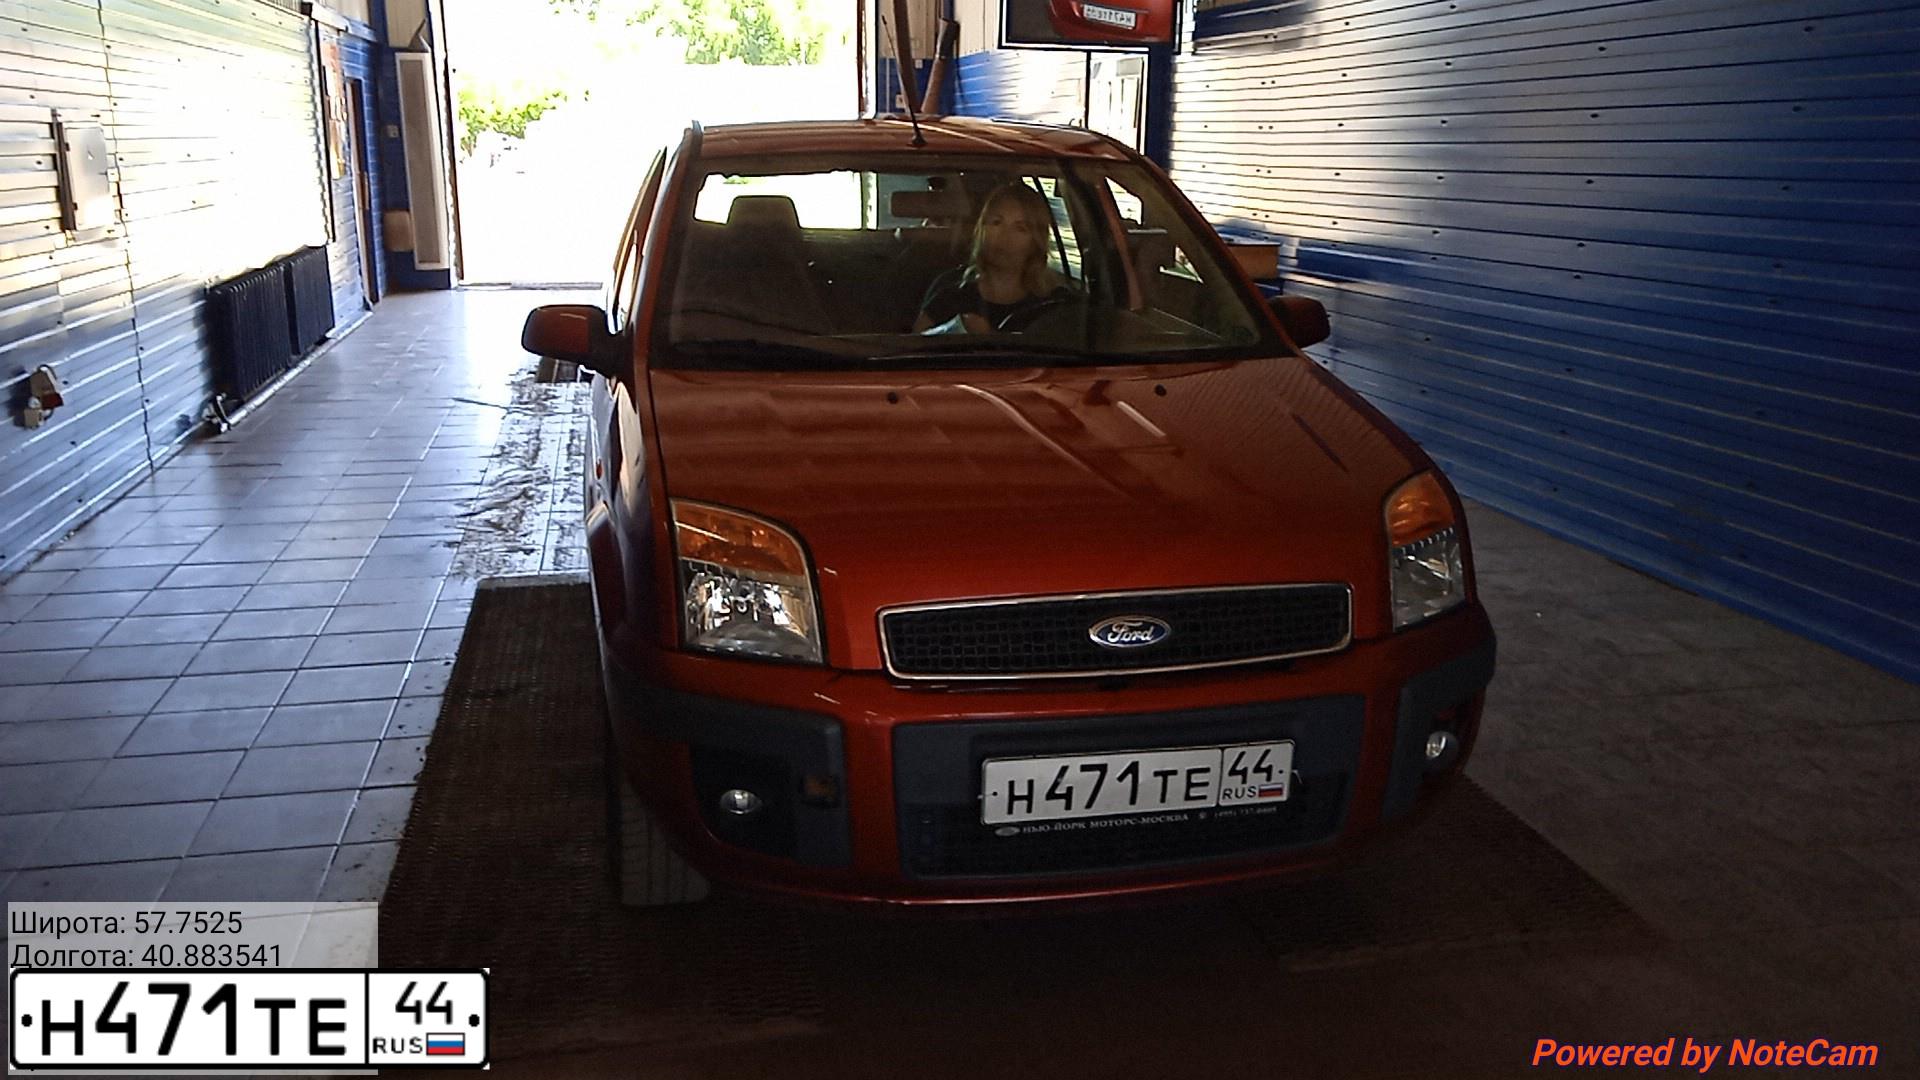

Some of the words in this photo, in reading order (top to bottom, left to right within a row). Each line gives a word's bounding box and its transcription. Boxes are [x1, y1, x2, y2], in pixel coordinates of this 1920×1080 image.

[1107, 621, 1154, 643] Ford
[1007, 760, 1211, 815] Н471ТЕ
[1228, 749, 1274, 785] 44
[1223, 785, 1257, 800] RUS
